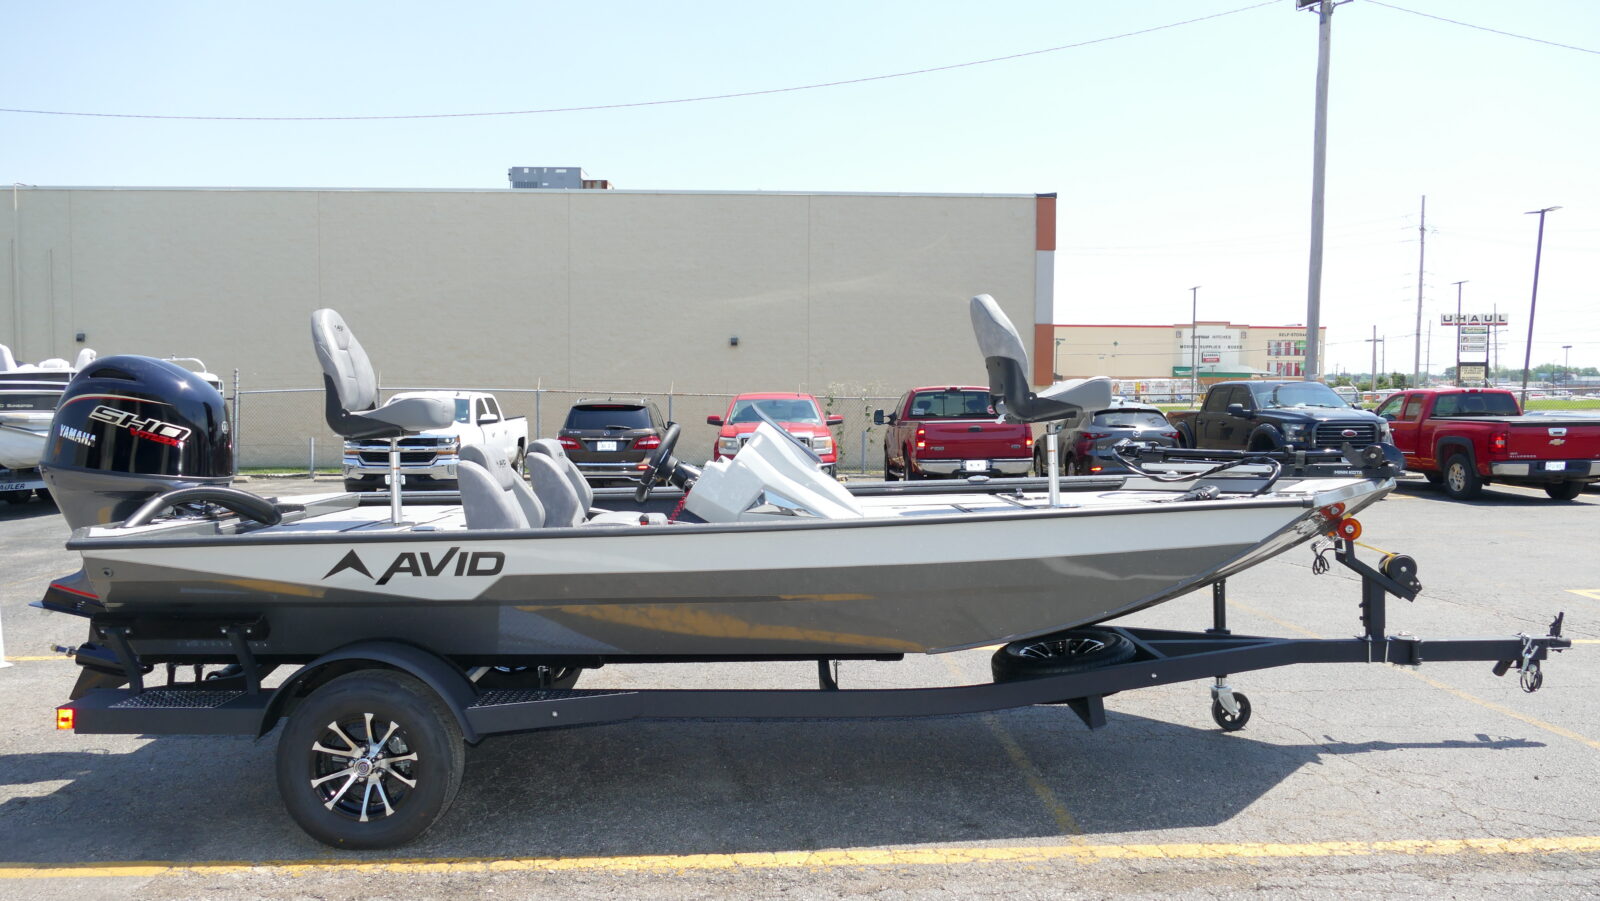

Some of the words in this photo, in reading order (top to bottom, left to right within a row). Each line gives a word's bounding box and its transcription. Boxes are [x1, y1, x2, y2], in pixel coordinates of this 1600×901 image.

[59, 423, 97, 448] YAMAHA
[88, 405, 192, 442] SHO
[375, 546, 506, 586] AVID
